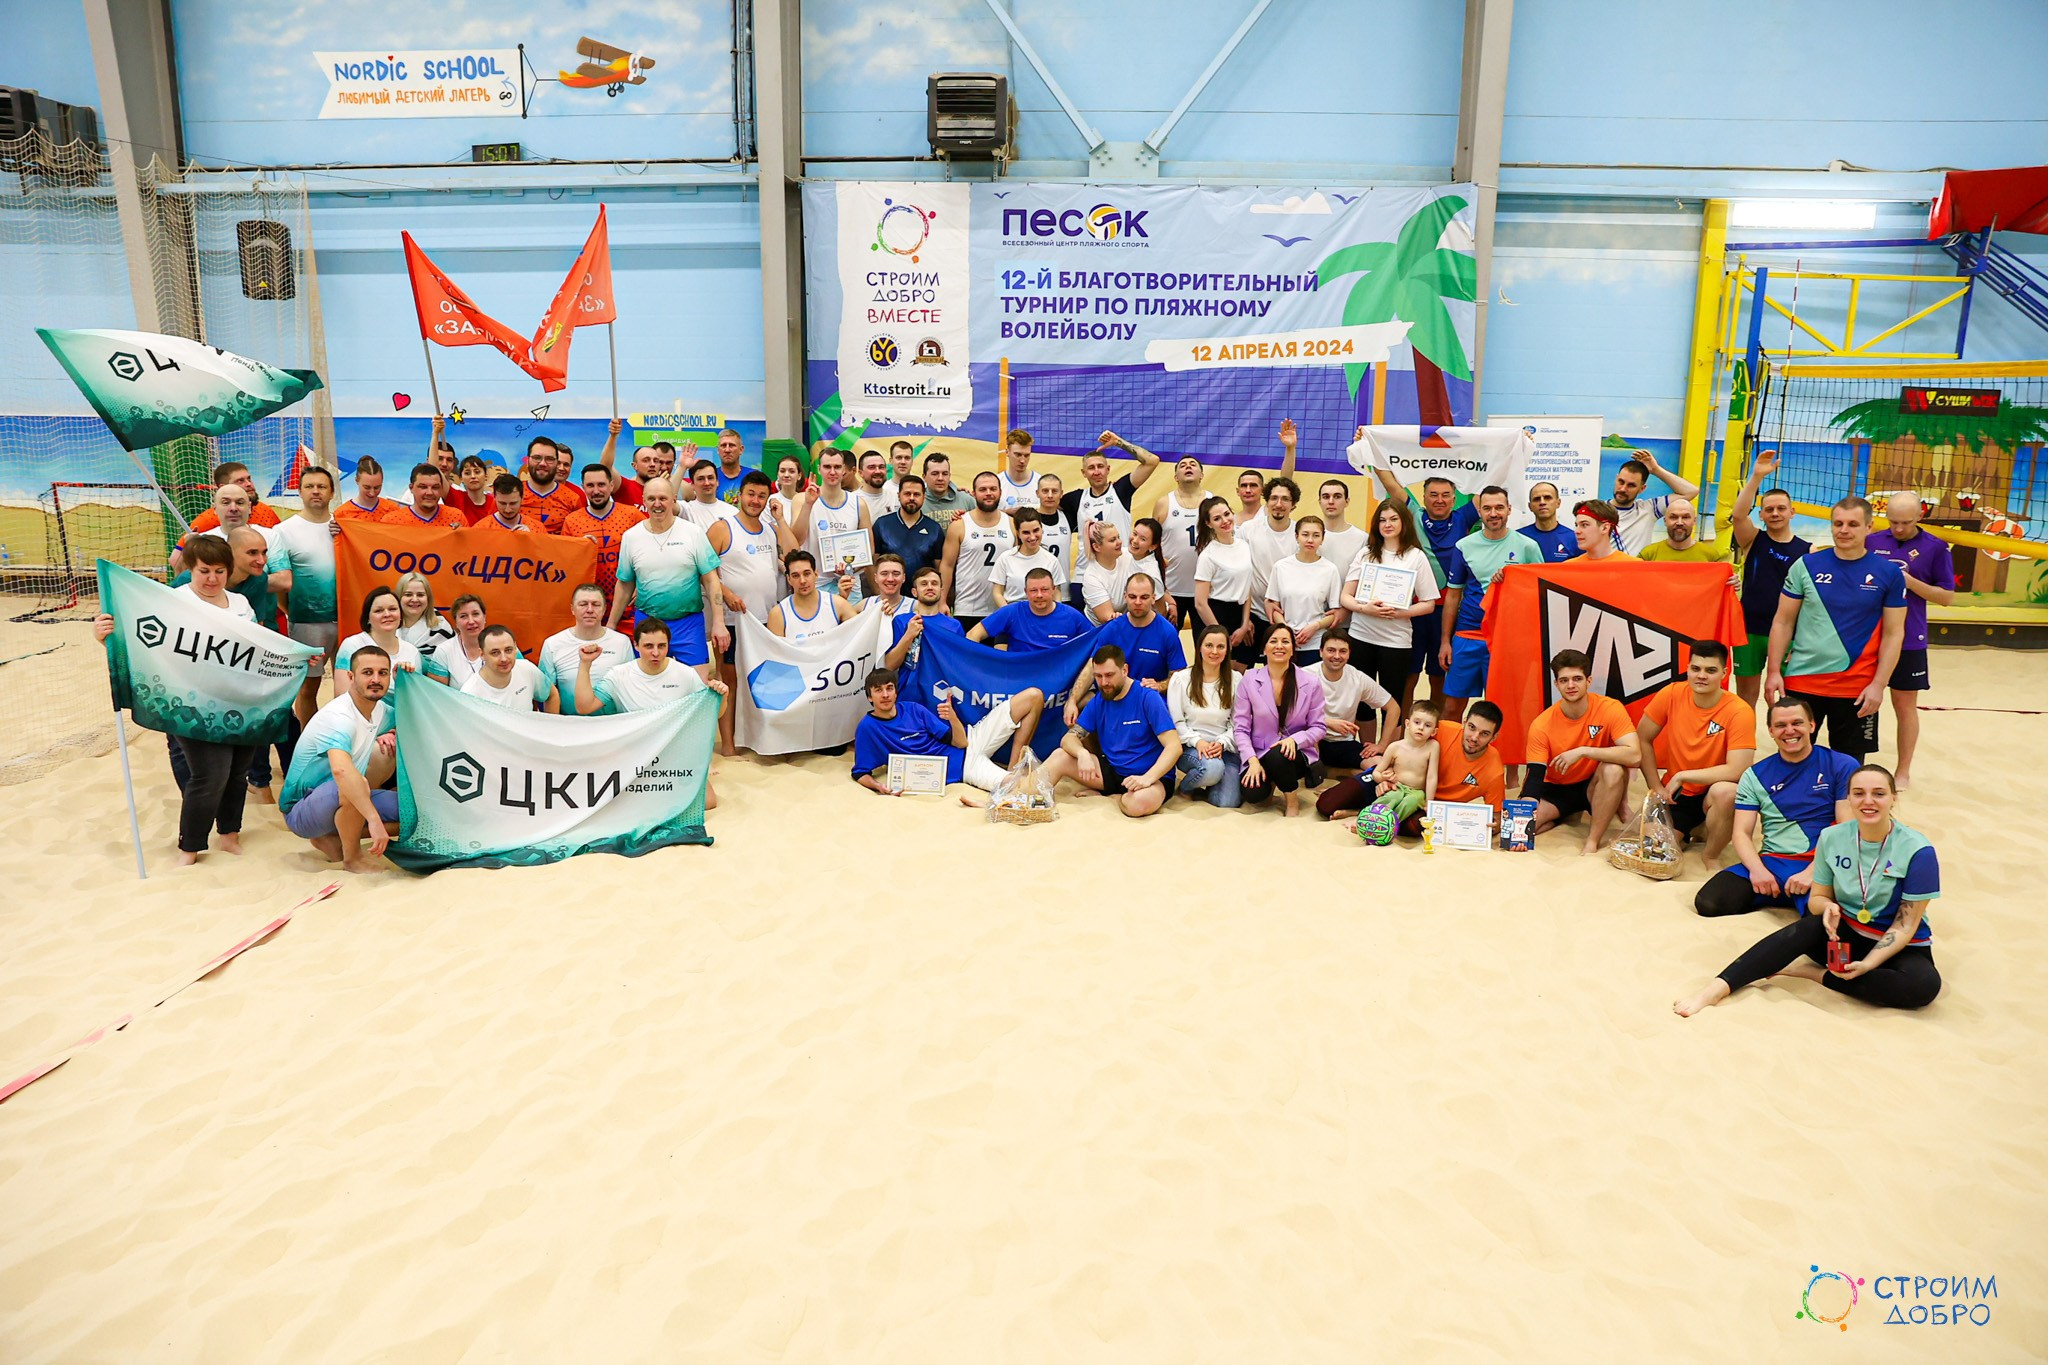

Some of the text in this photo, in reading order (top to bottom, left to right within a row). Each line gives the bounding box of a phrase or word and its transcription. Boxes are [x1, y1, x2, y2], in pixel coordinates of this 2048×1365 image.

[423, 55, 504, 80] SCHOOL
[337, 85, 491, 104] ЛЮБИМЫЙ ДЕТСКИЙ ЛАГЕРЬ
[499, 91, 512, 100] GO
[481, 145, 519, 161] 15:07
[866, 272, 940, 286] СТРОИМ
[1001, 268, 1319, 292] 12-Й БЛАГОТВОРИТЕЛЬНЫЙ
[871, 289, 935, 303] ДОБРО
[867, 308, 942, 323] ВМЕСТЕ
[1001, 296, 1272, 318] ТУРНИР ПО ПЛЯЖНОМУ
[1001, 319, 1137, 340] ВОЛЕЙБОЛУ
[1191, 339, 1354, 361] 12 АПРЕЛЯ 2024
[1388, 455, 1488, 473] Ростелеком
[829, 521, 848, 529] SOTA
[1186, 525, 1196, 547] 1
[755, 544, 773, 552] SOTA
[983, 543, 996, 567] 2
[369, 549, 567, 584] ООО «ЦДСК»
[1815, 573, 1833, 583] 22
[174, 627, 255, 671] ЦКИ
[263, 650, 289, 663] Центр
[257, 667, 293, 678] Изделий
[500, 767, 621, 816] ЦКИ
[1835, 855, 1852, 869] 10
